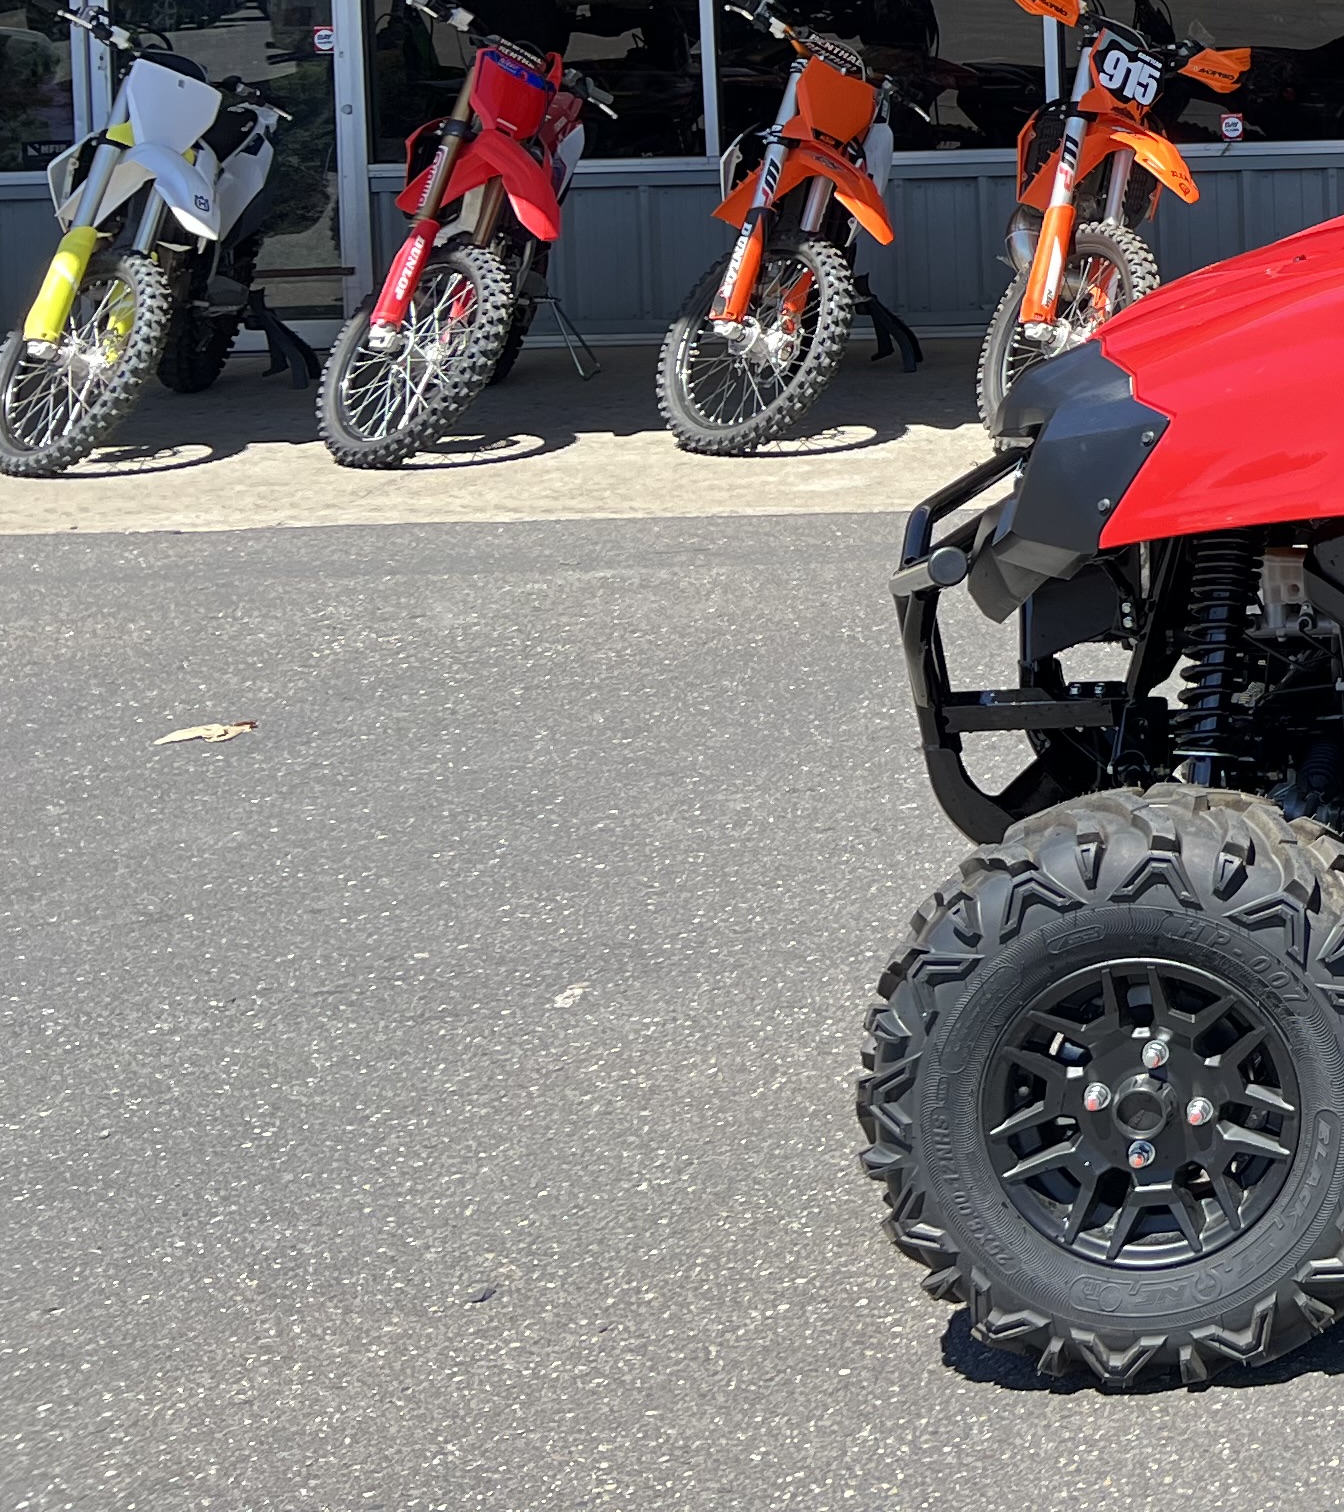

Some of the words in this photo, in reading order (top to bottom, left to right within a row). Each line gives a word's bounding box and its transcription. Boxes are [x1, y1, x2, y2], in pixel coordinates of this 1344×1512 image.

[1098, 49, 1161, 106] 915
[395, 234, 426, 301] DUNLOP
[1176, 917, 1308, 1010] HP-007
